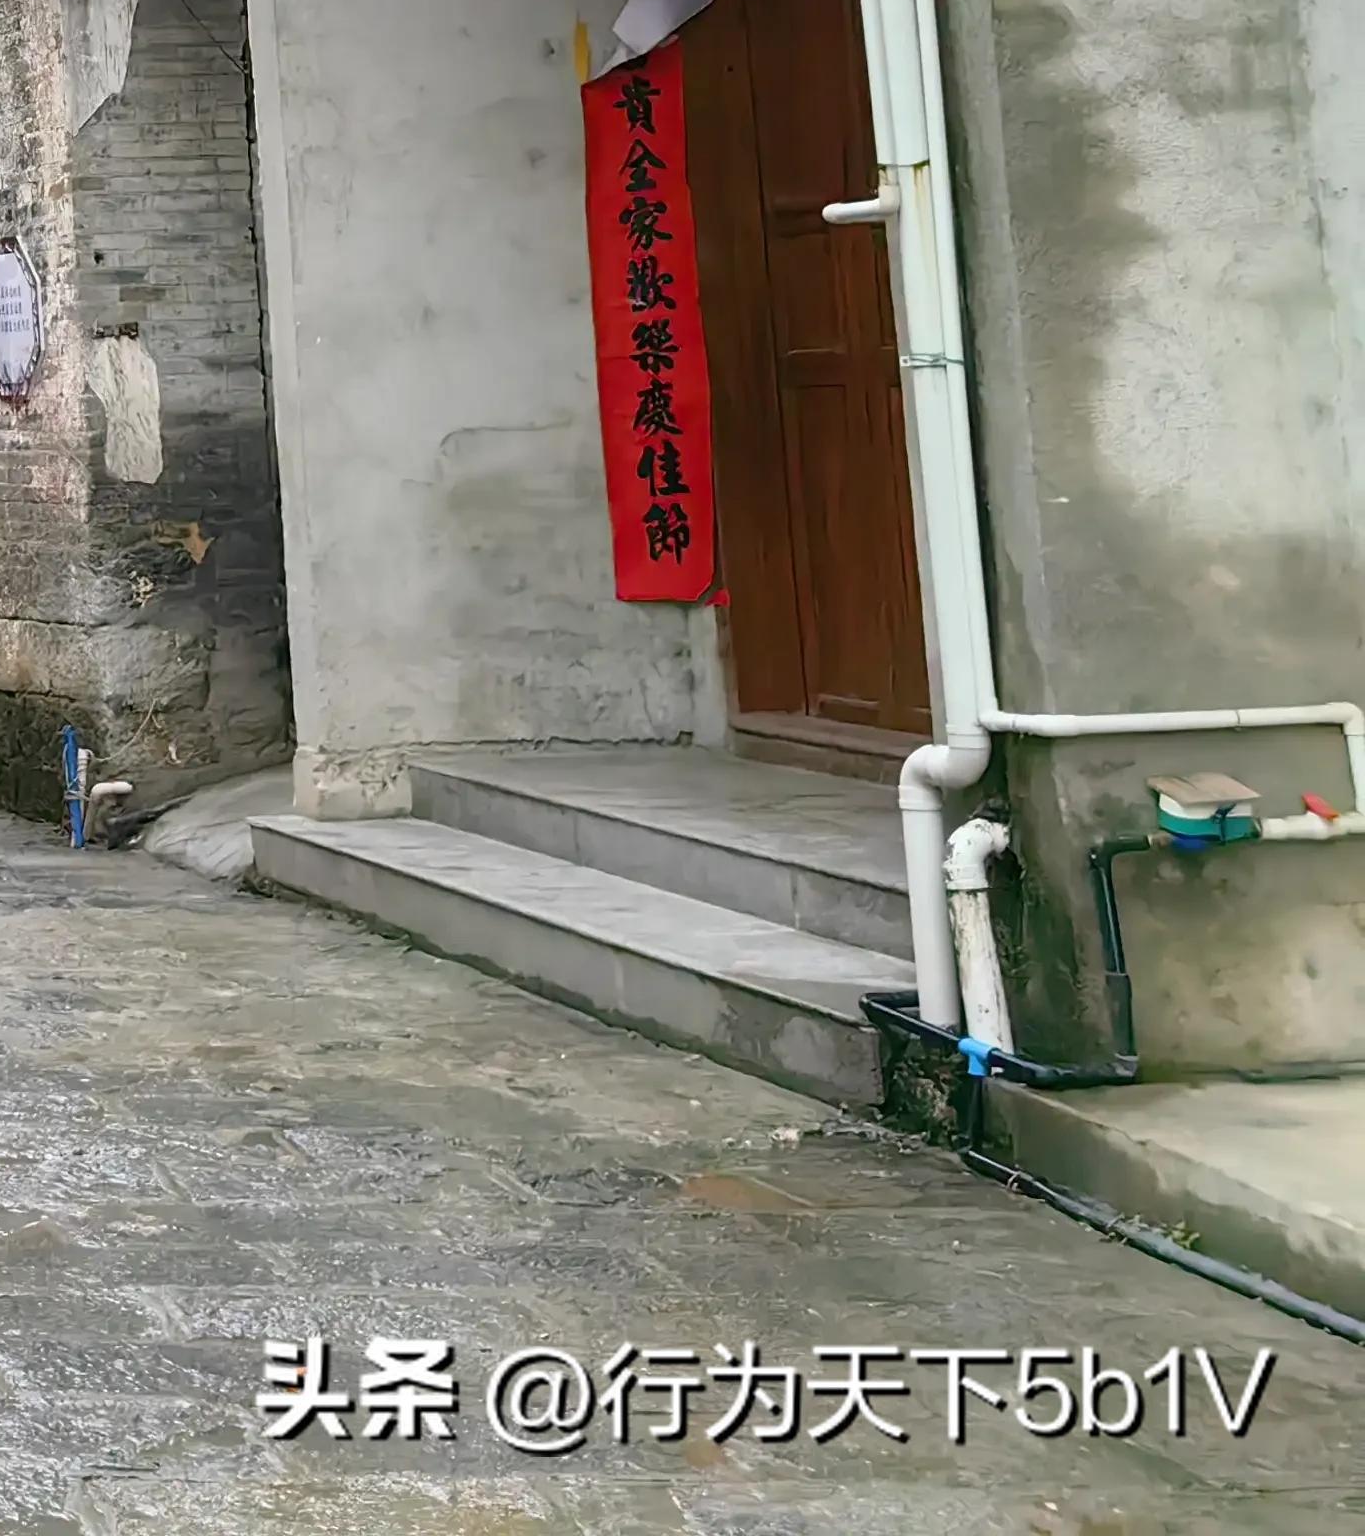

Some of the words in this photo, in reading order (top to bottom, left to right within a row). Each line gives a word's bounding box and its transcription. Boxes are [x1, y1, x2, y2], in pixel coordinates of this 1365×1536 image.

[613, 55, 690, 565] 貴全家歡樂慶佳節
